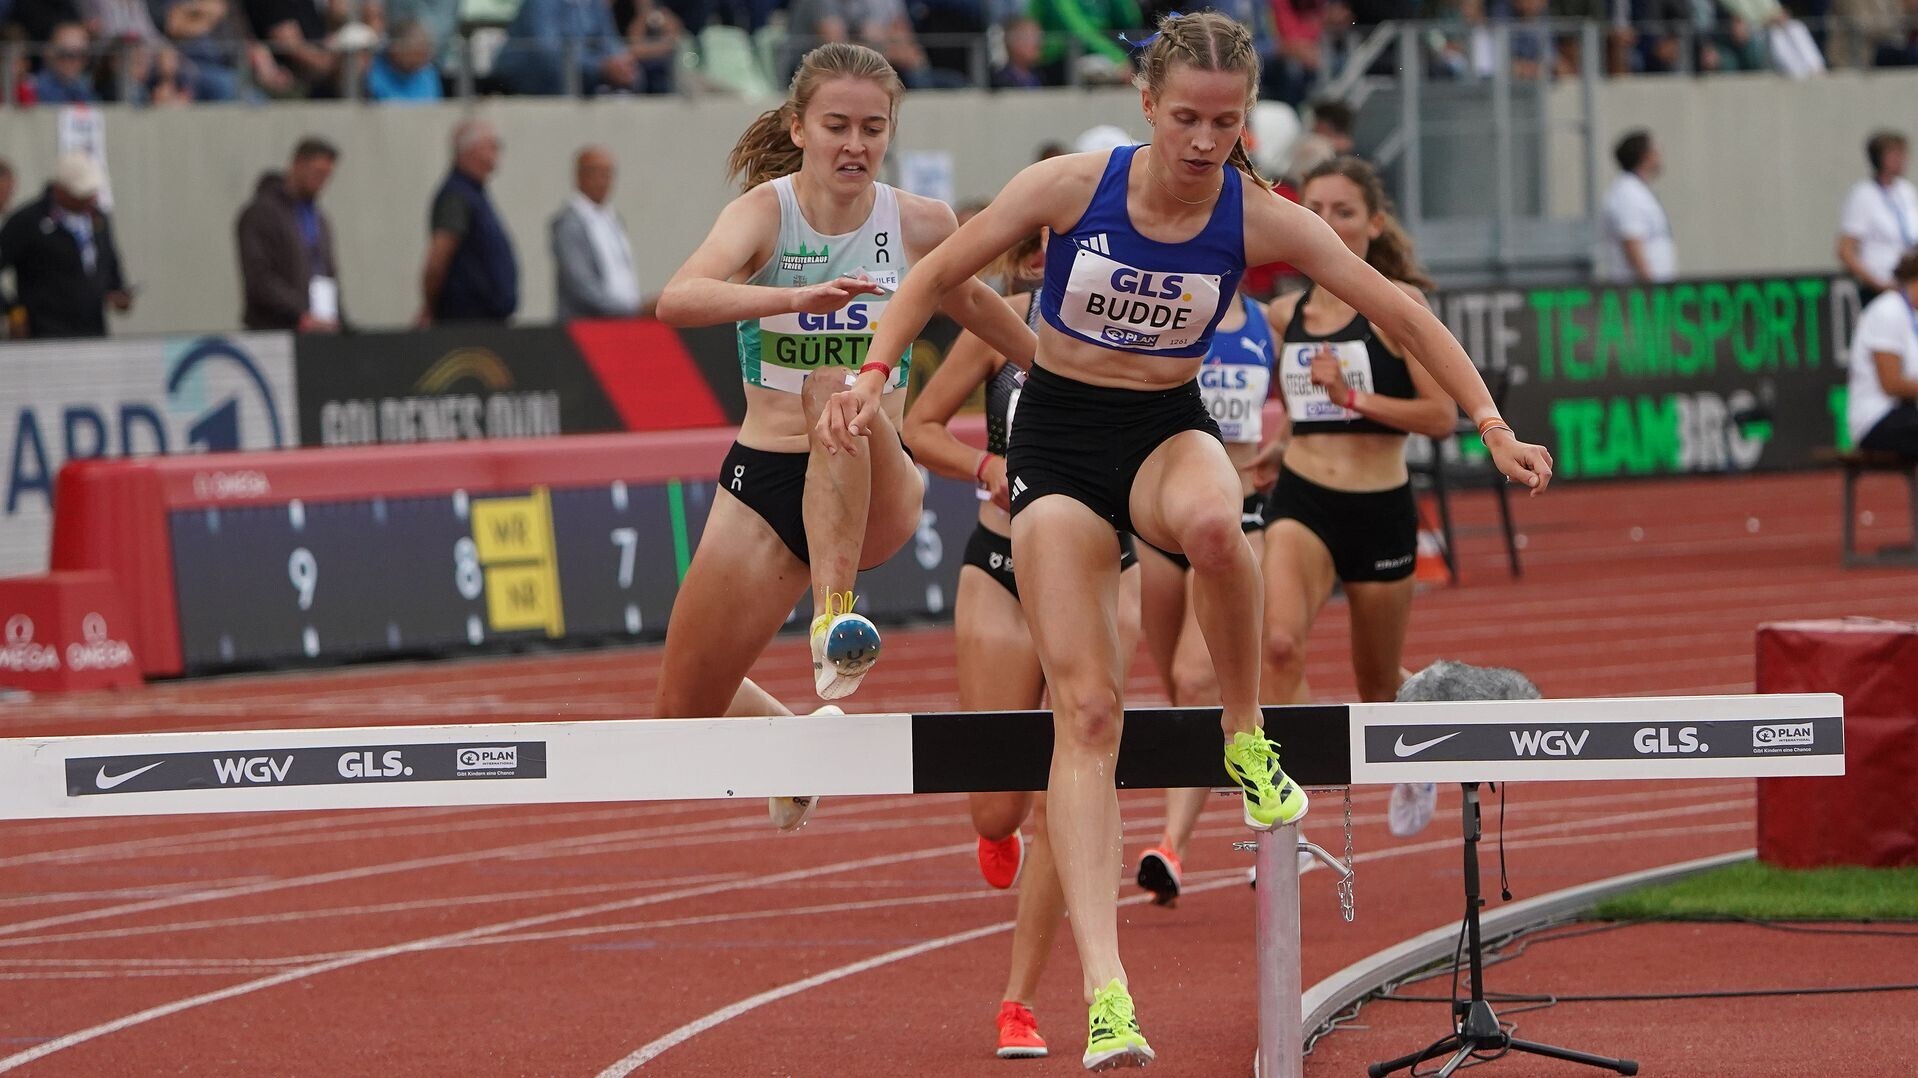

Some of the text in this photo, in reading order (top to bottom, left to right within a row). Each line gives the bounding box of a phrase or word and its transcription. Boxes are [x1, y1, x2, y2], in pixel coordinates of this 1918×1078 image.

[1110, 267, 1192, 303] GLS.
[1086, 292, 1192, 330] BUDDE
[1126, 332, 1157, 344] PLAN
[1528, 279, 1825, 380] TEAMSPORT
[776, 335, 873, 366] GÜRT
[453, 536, 484, 600] 8
[610, 526, 639, 589] 7
[288, 547, 318, 610] 9
[0, 643, 61, 672] MEGA
[65, 640, 135, 672] OMEGA
[1509, 729, 1590, 756] WGV
[1633, 726, 1710, 754] GLS.
[1778, 727, 1811, 738] PLAN
[213, 754, 294, 785] WGV
[337, 750, 414, 779] GLS.
[482, 751, 514, 761] PLAN
